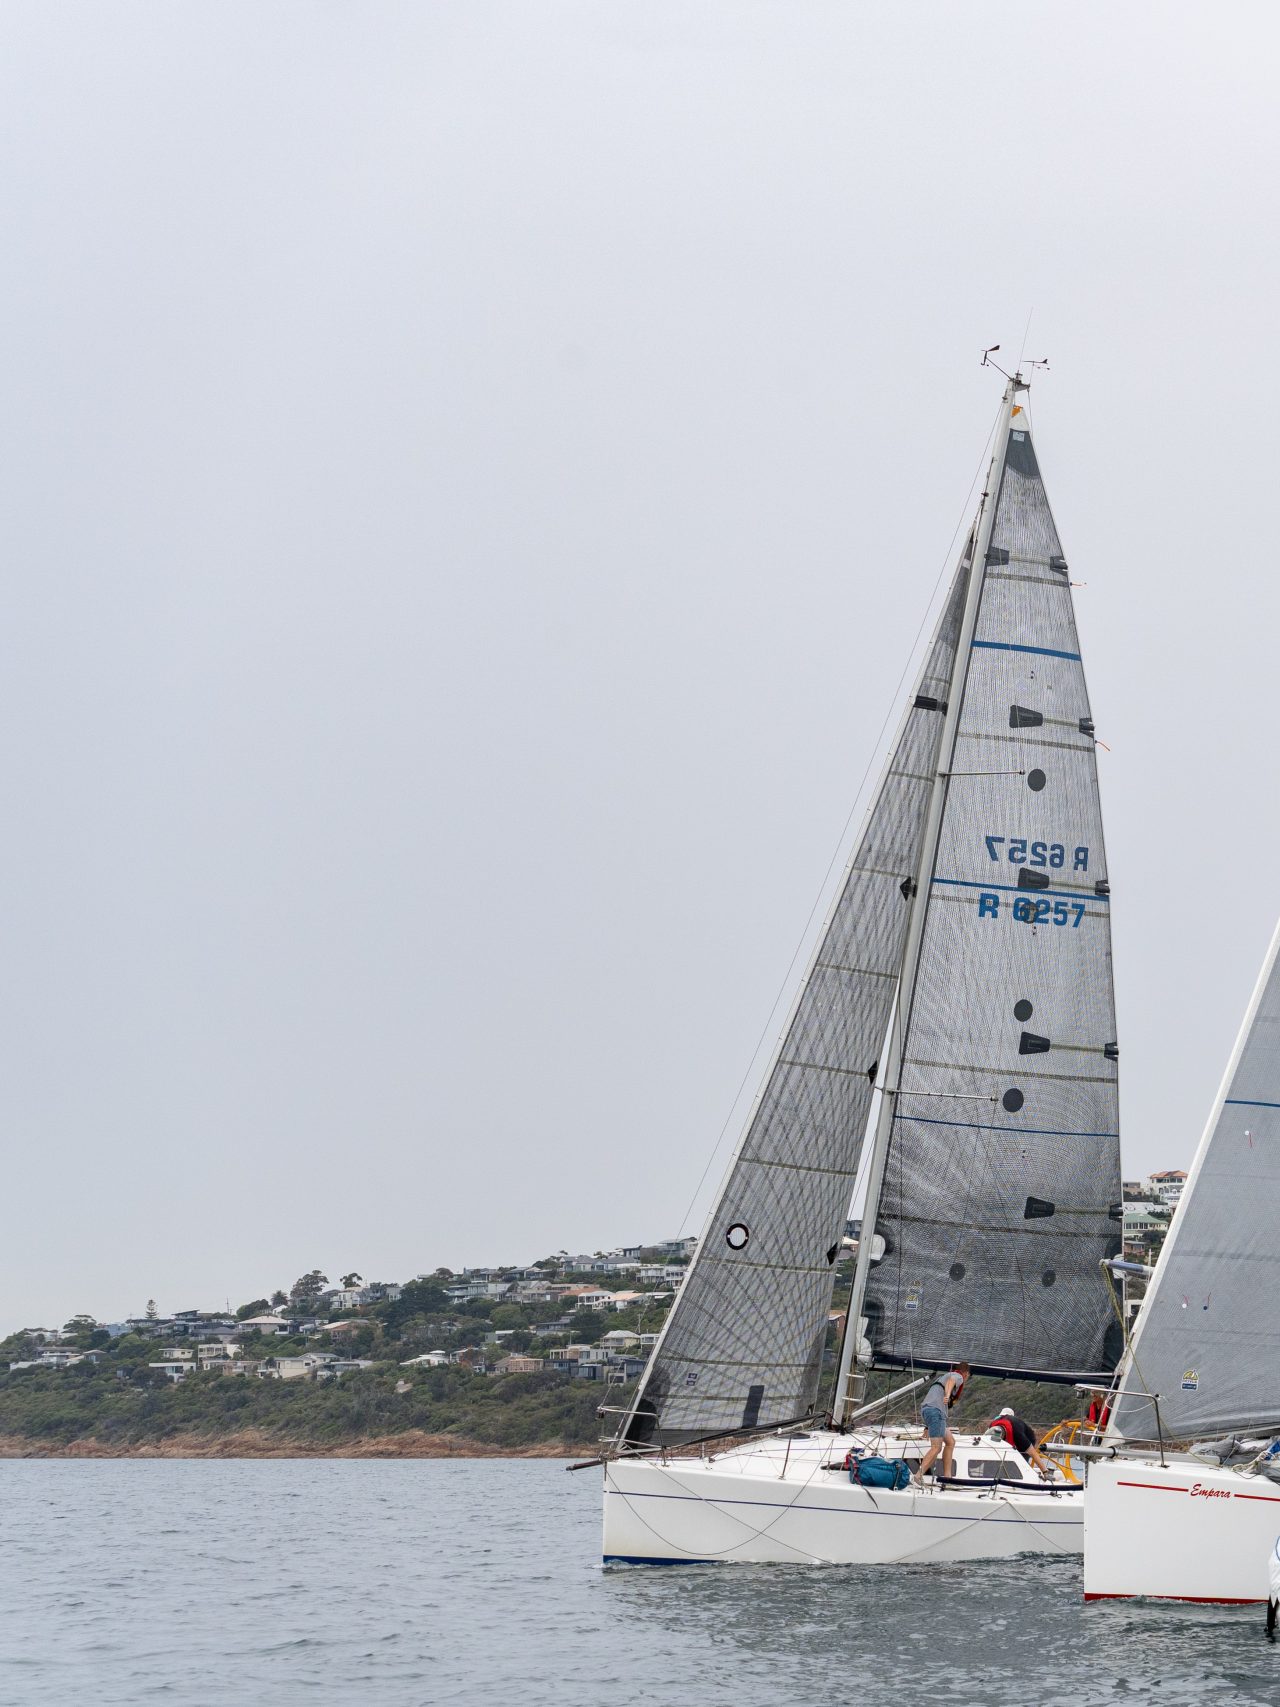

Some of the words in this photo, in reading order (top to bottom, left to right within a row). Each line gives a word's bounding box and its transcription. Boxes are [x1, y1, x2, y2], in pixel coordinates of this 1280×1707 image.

[978, 892, 1000, 919] R
[1012, 896, 1086, 928] 6257
[1190, 1483, 1232, 1500] Empara
